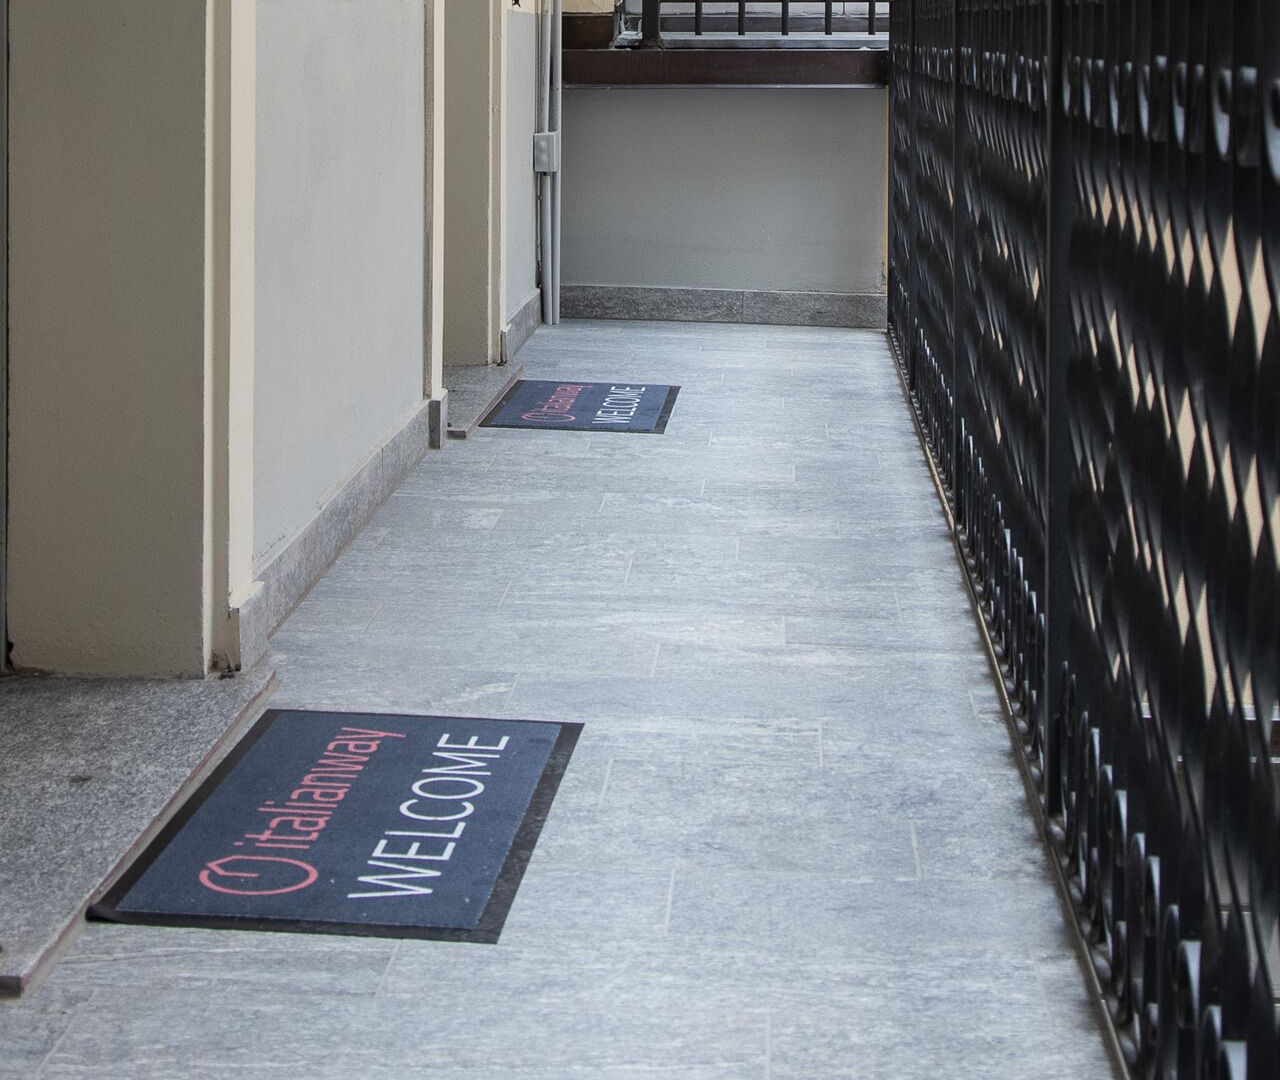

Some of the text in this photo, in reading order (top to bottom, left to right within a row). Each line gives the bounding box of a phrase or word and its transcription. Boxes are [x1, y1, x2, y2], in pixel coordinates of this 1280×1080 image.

[591, 385, 647, 424] WELCOME
[234, 726, 406, 850] italianway
[347, 733, 511, 899] WELCOME
